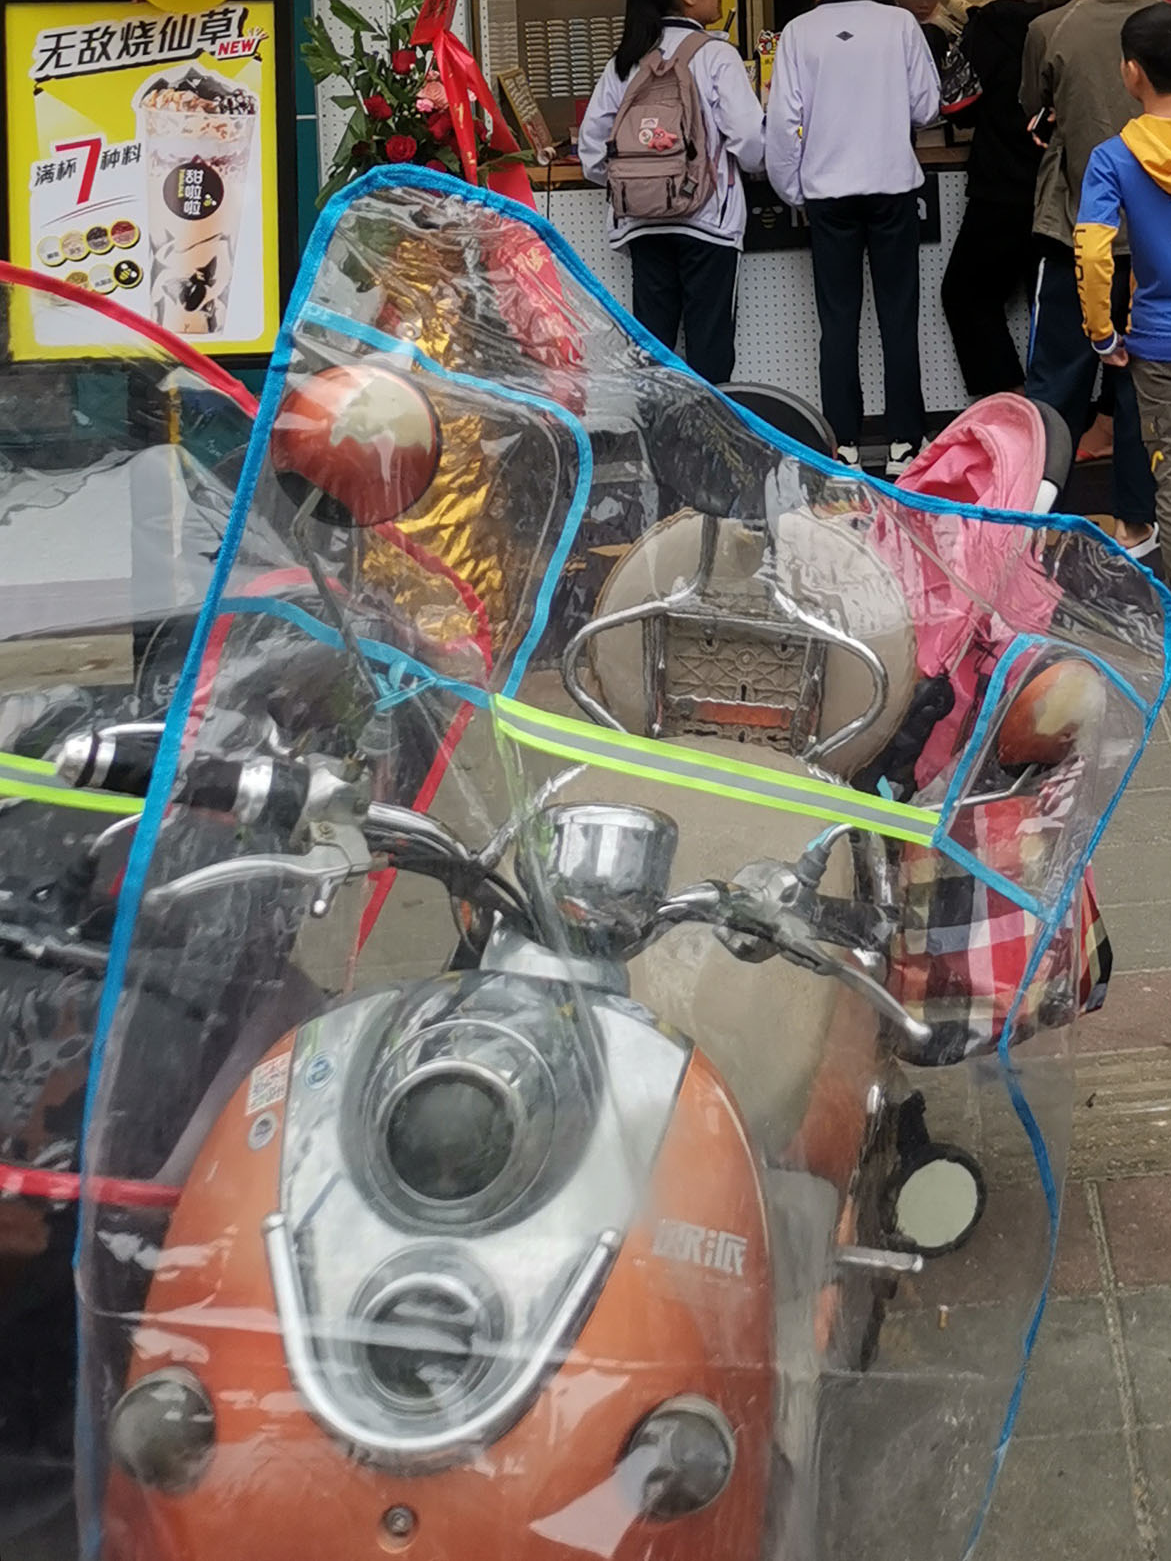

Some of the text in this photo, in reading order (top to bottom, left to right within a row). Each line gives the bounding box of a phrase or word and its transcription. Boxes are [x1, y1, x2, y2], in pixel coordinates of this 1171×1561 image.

[40, 8, 241, 72] 无敌烧仙草
[217, 37, 256, 59] NEW
[183, 169, 205, 216] 甜啦啦
